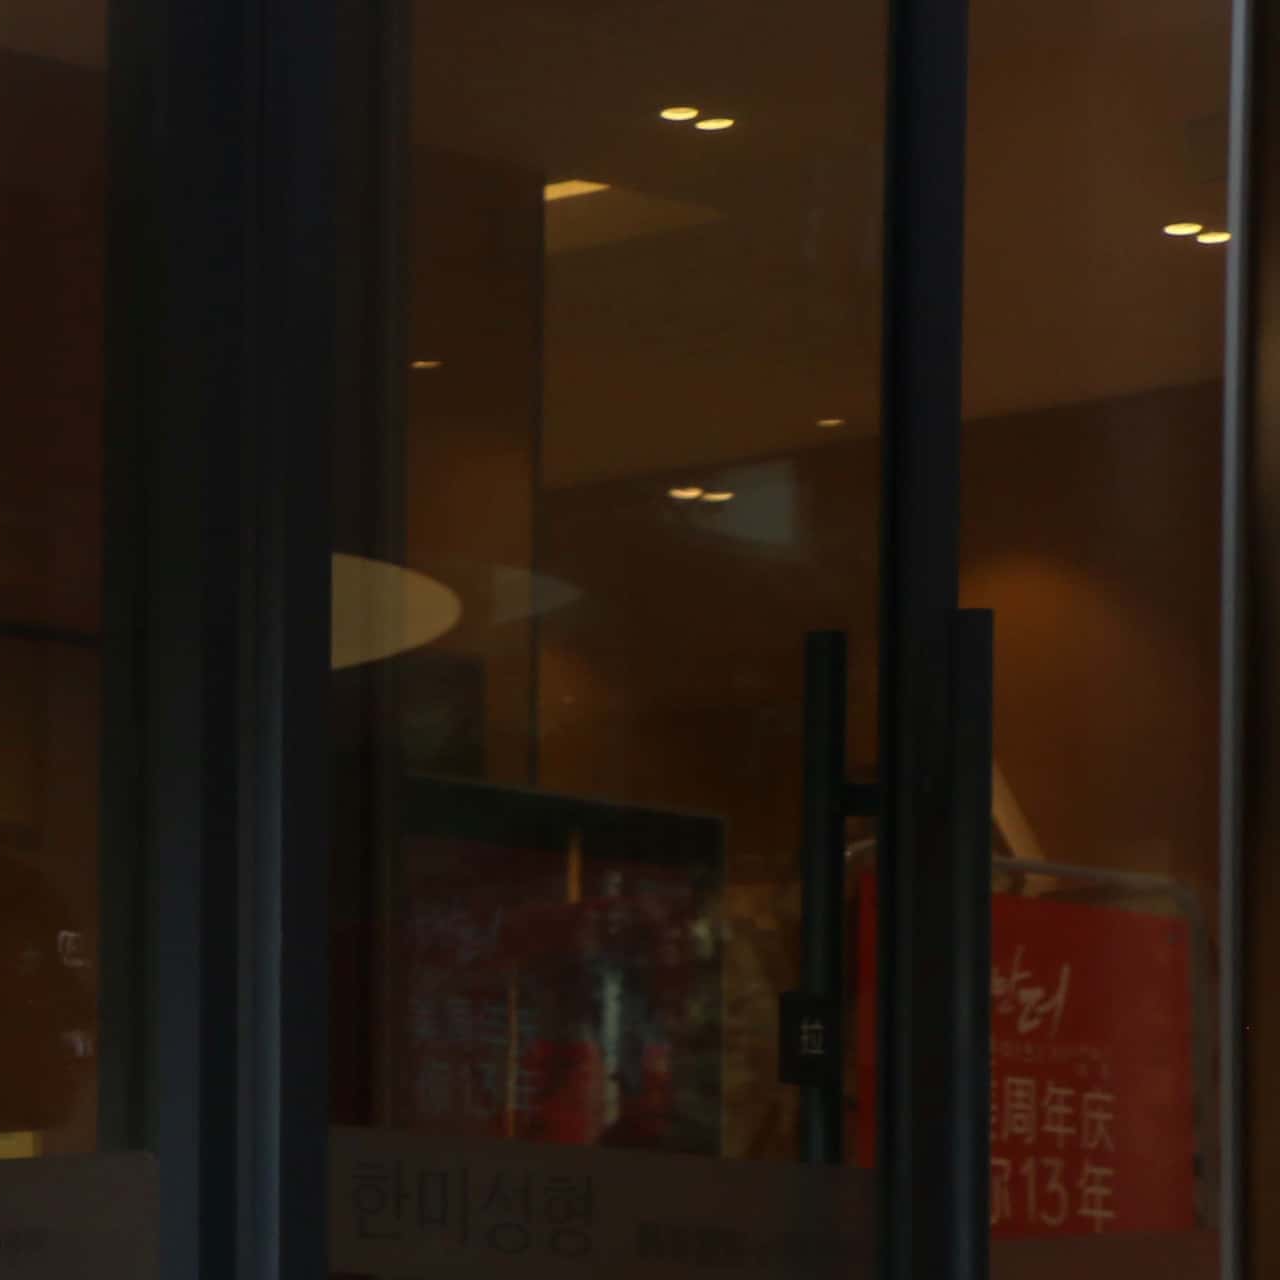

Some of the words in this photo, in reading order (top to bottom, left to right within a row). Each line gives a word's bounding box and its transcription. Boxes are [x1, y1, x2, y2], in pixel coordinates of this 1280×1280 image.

[991, 1076, 1118, 1152] 周年庆
[349, 1157, 595, 1256] 한미성형
